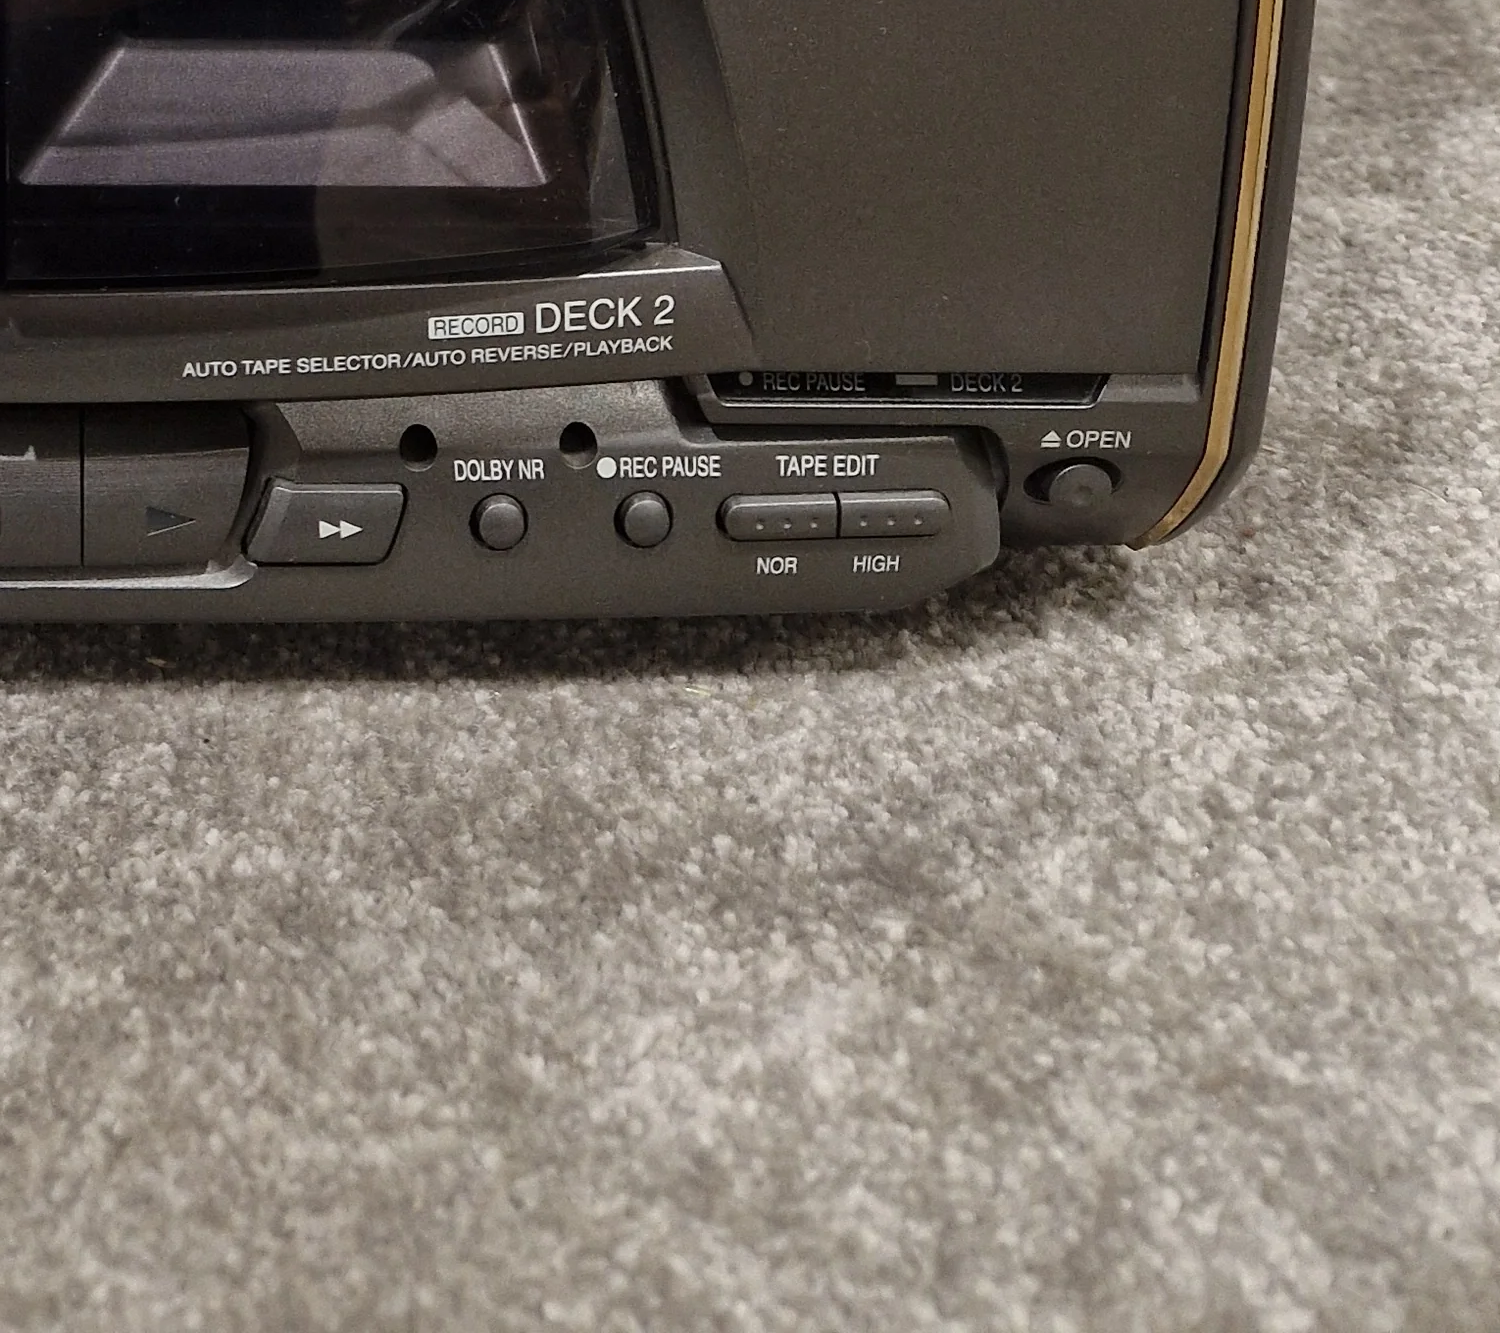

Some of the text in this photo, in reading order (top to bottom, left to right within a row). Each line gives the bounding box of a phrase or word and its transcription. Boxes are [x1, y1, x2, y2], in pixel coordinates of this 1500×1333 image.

[433, 294, 676, 337] RECORD DECK 2
[181, 335, 674, 378] AUTO TAPE SELECTOR/AUTO REVERSE/PLAYBACK
[763, 372, 866, 392] REC PAUSE
[951, 373, 1023, 393] DECK 2
[1065, 430, 1132, 449] OPEN
[453, 459, 546, 482] DOLBY NR
[619, 455, 722, 479] REC PAUSE
[776, 454, 880, 477] TAPE EDIT
[756, 556, 798, 575] NOR
[852, 555, 900, 573] HIGH
